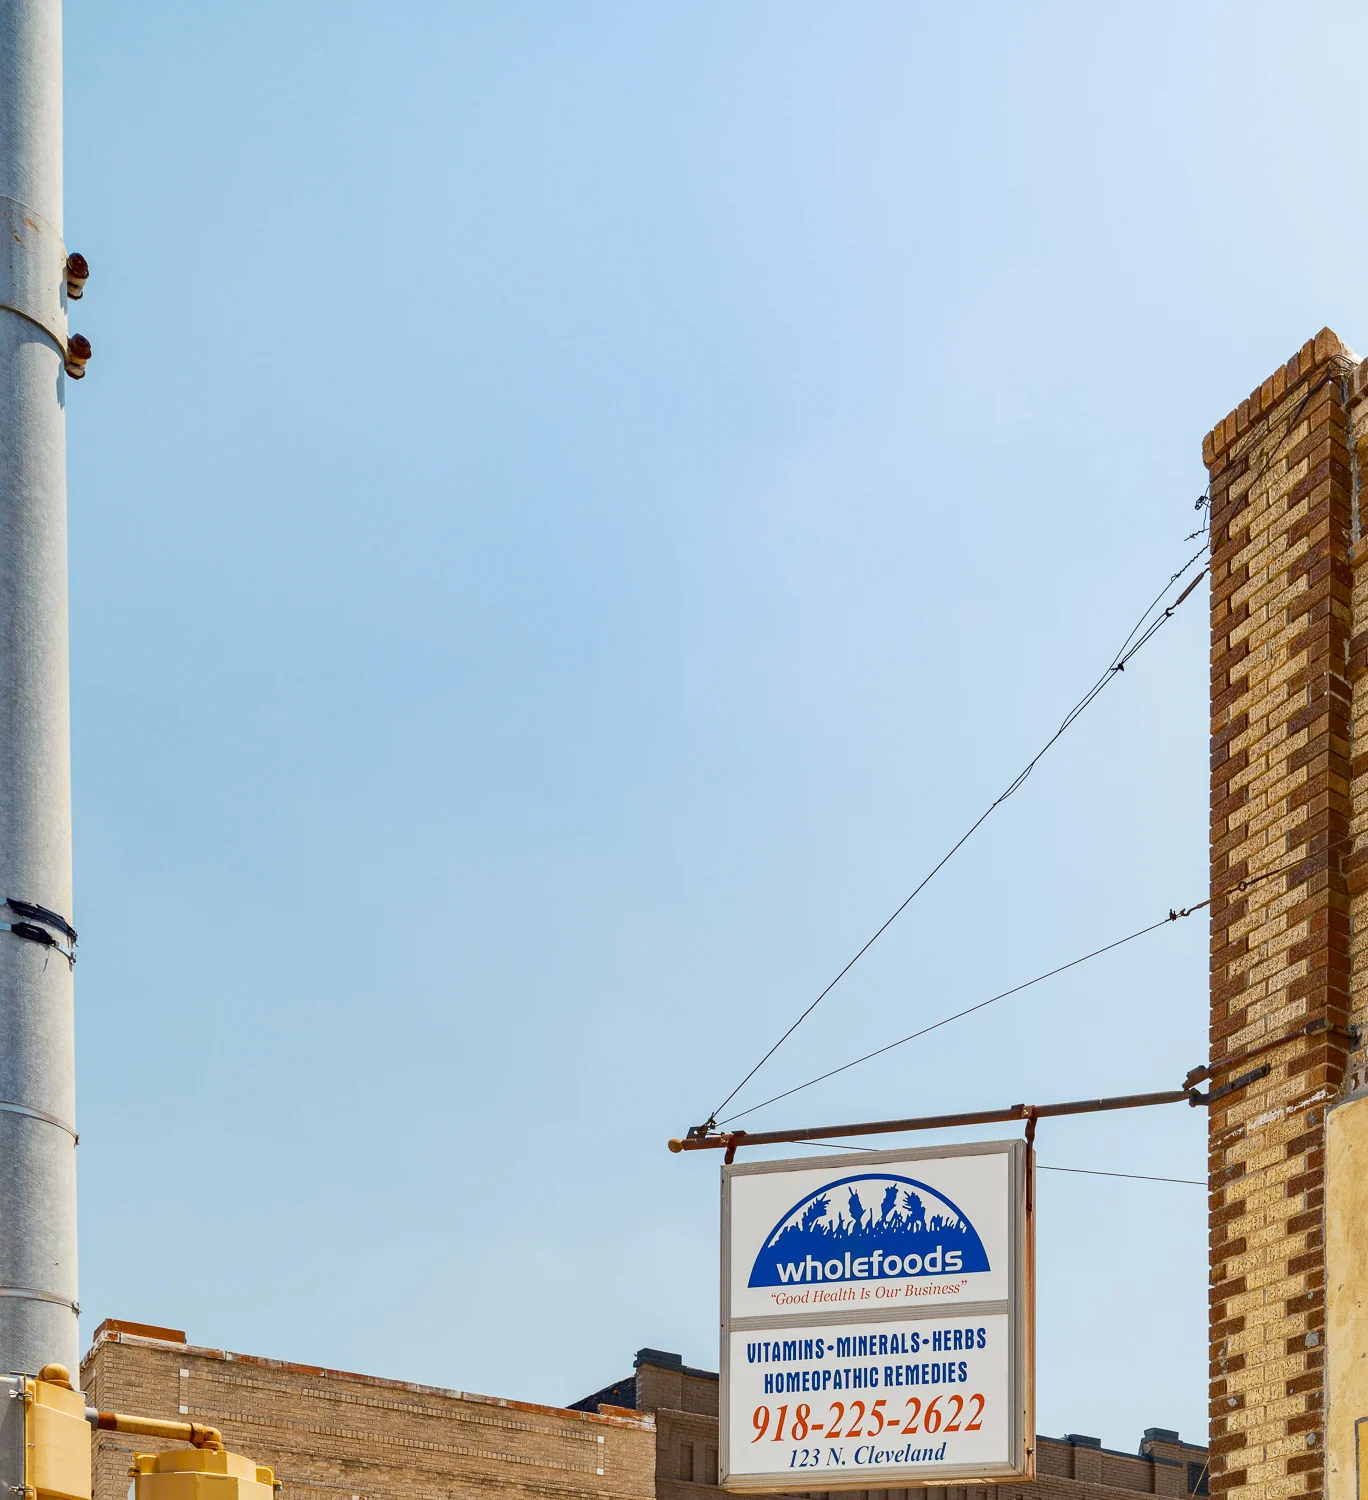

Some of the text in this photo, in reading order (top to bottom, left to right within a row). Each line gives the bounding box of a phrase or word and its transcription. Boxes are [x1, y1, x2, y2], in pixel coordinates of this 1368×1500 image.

[776, 1246, 963, 1283] wholefoods
[812, 1285, 856, 1303] Health
[860, 1286, 871, 1300] Is
[875, 1285, 902, 1300] Our
[764, 1361, 968, 1394] HOMEOPATHIC REMEDIES
[751, 1393, 986, 1443] 918-225-2622
[789, 1442, 948, 1468] 123 N. Cleveland
